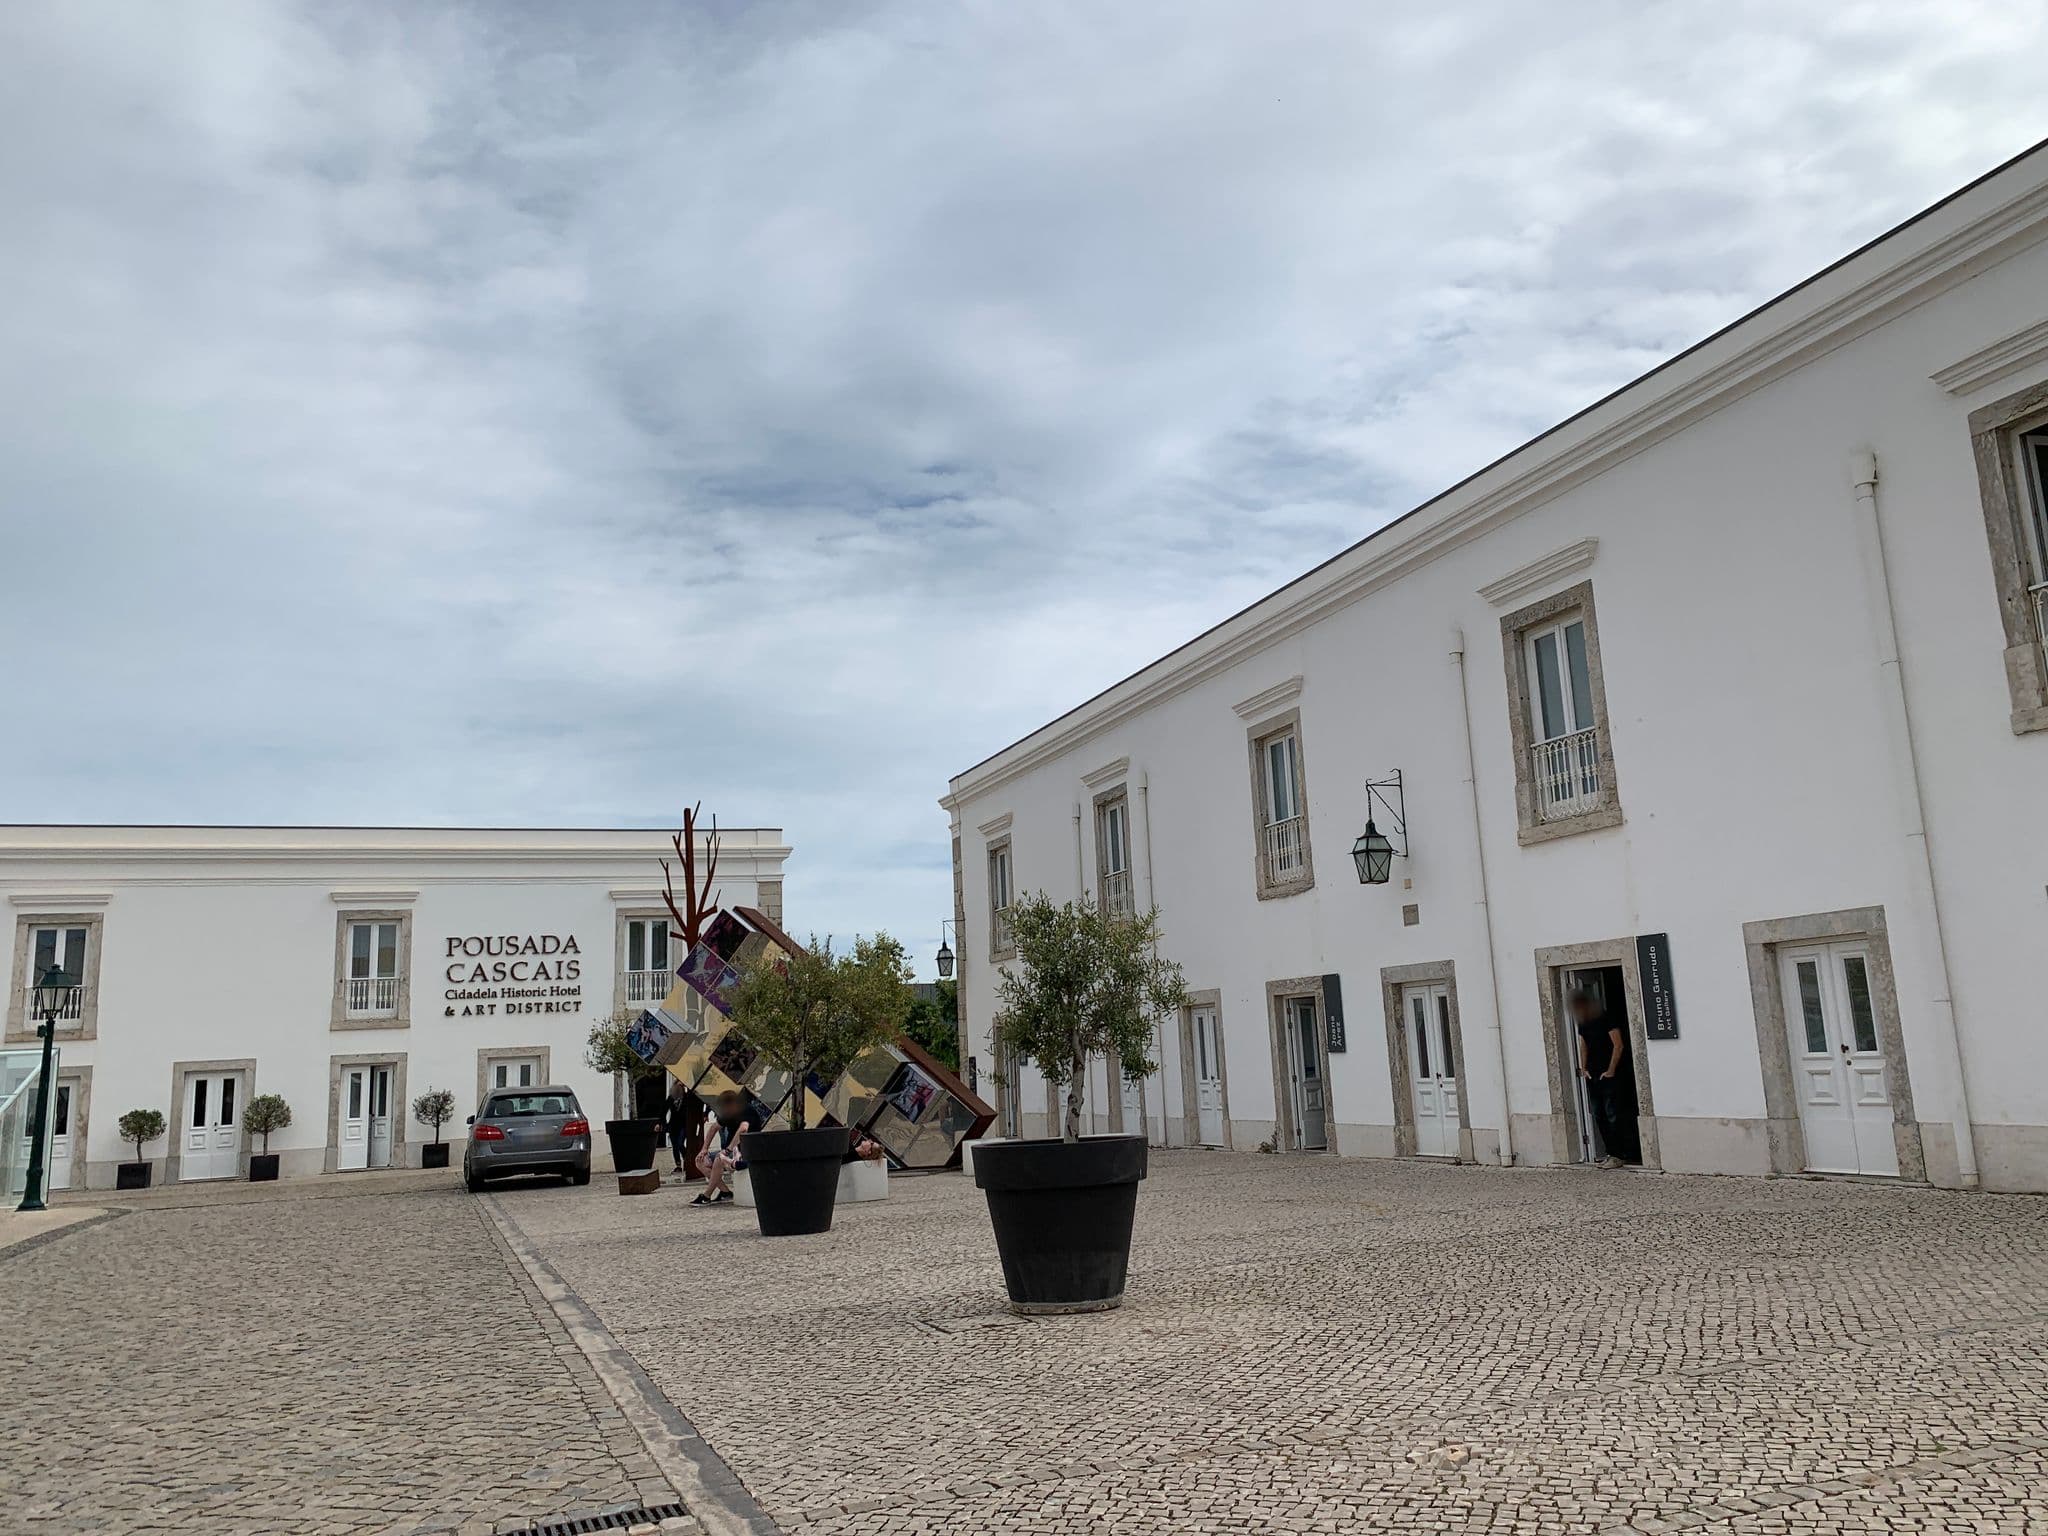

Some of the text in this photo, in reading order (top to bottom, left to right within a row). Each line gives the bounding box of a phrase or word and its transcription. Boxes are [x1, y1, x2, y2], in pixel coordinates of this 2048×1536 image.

[446, 934, 581, 957] POUSADA
[446, 960, 581, 983] CASCAIS
[445, 985, 581, 1000] Cidadela Historic Hotel
[1650, 946, 1665, 1031] Bruno Garrudo
[445, 1001, 582, 1016] & ART DISTRICT
[1663, 990, 1671, 1017] Gallery
